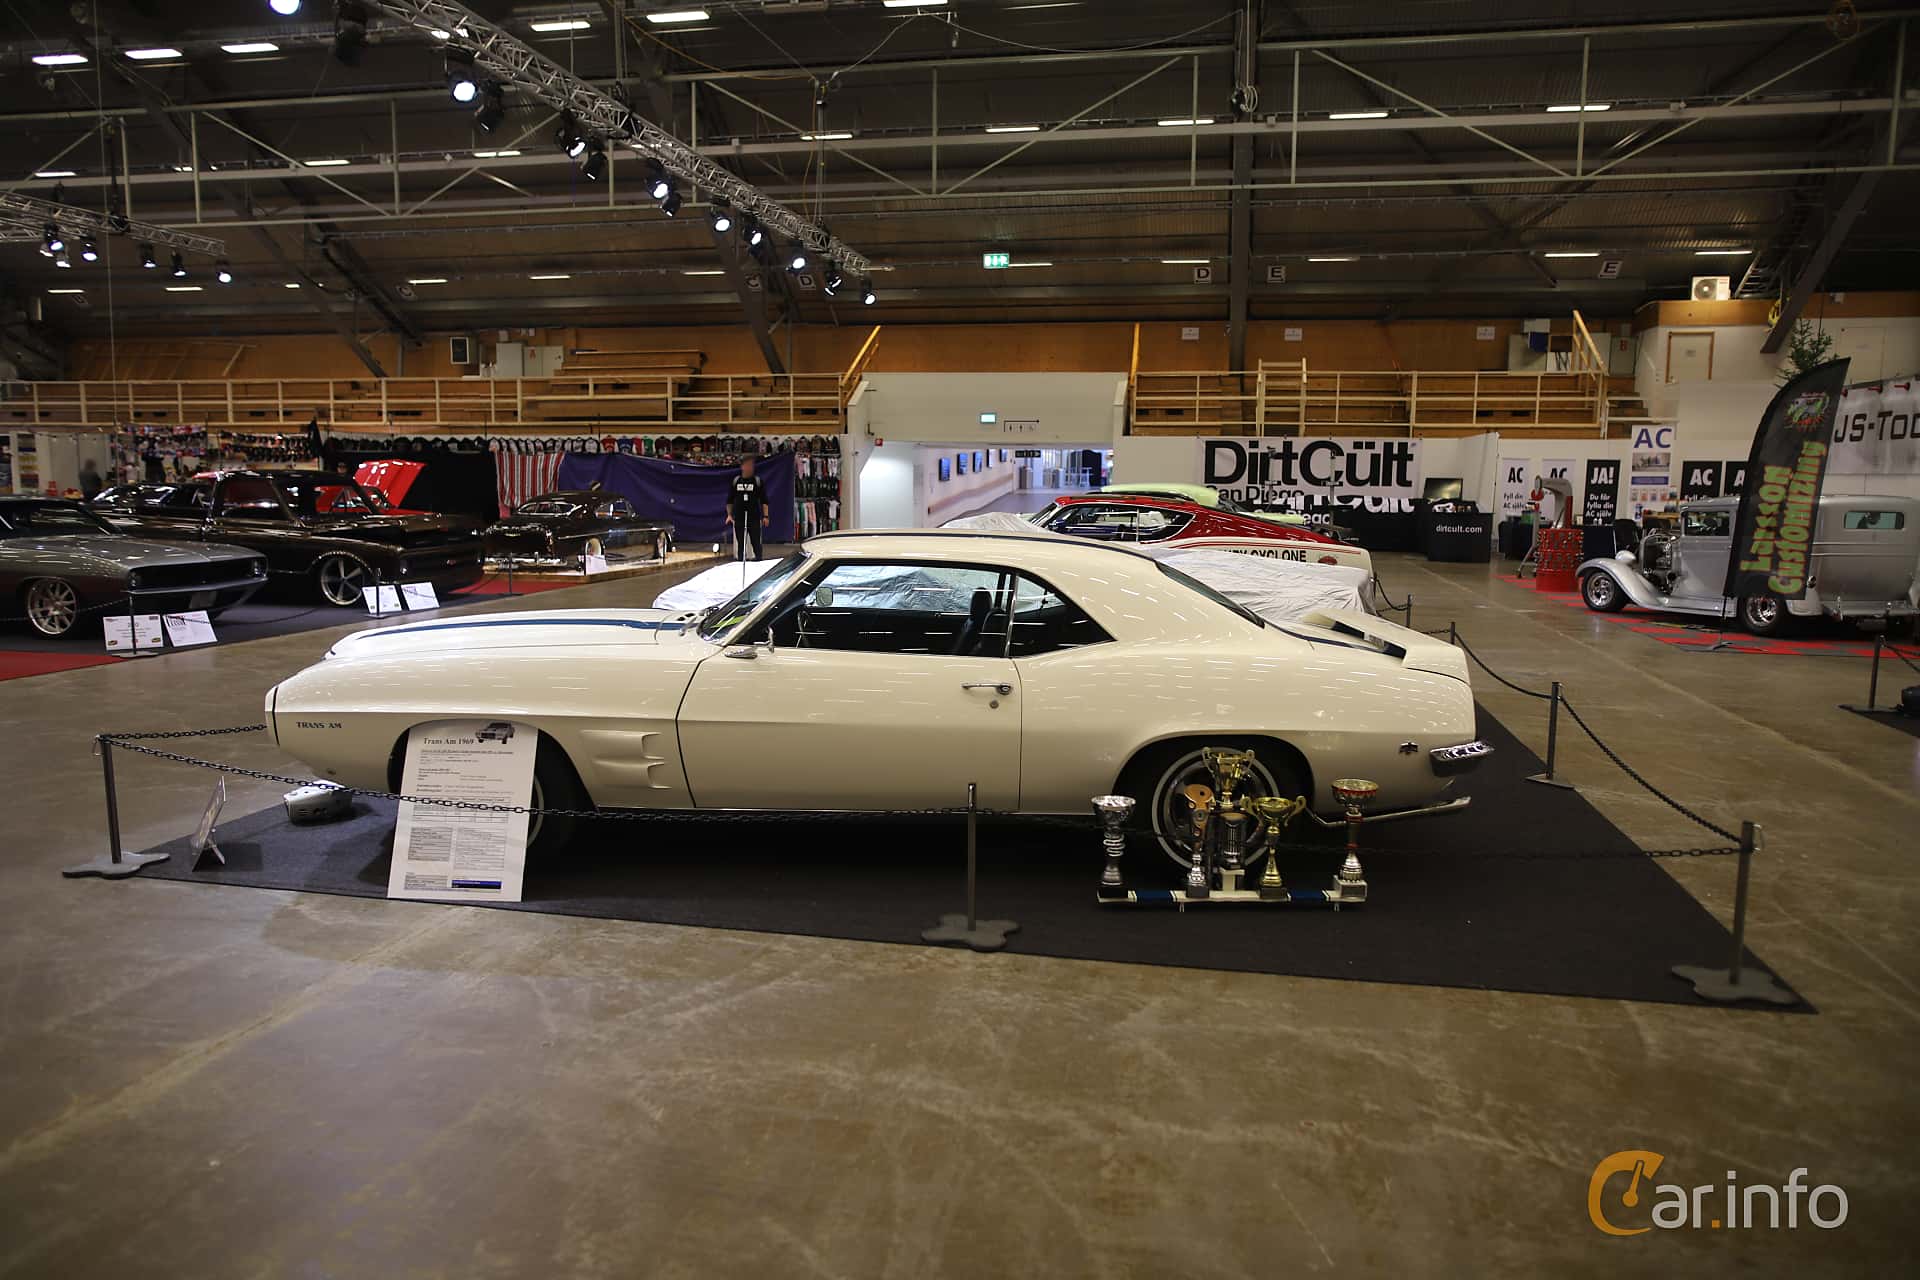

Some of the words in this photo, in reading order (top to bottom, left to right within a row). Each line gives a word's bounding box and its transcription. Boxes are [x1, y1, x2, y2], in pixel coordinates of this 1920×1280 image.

[1197, 268, 1210, 279] D
[1271, 267, 1282, 278] E
[1634, 428, 1673, 449] AC
[1204, 440, 1414, 487] DirtCült
[1508, 467, 1524, 484] AC
[1590, 466, 1615, 485] JA!
[1689, 468, 1713, 486] AC
[1733, 469, 1746, 487] A
[1740, 464, 1793, 572] Larsson
[1767, 440, 1827, 595] Customizing
[1435, 524, 1483, 534] dirtcult.com
[295, 721, 325, 729] TRANS
[423, 737, 443, 745] Trans
[445, 737, 457, 745] Am
